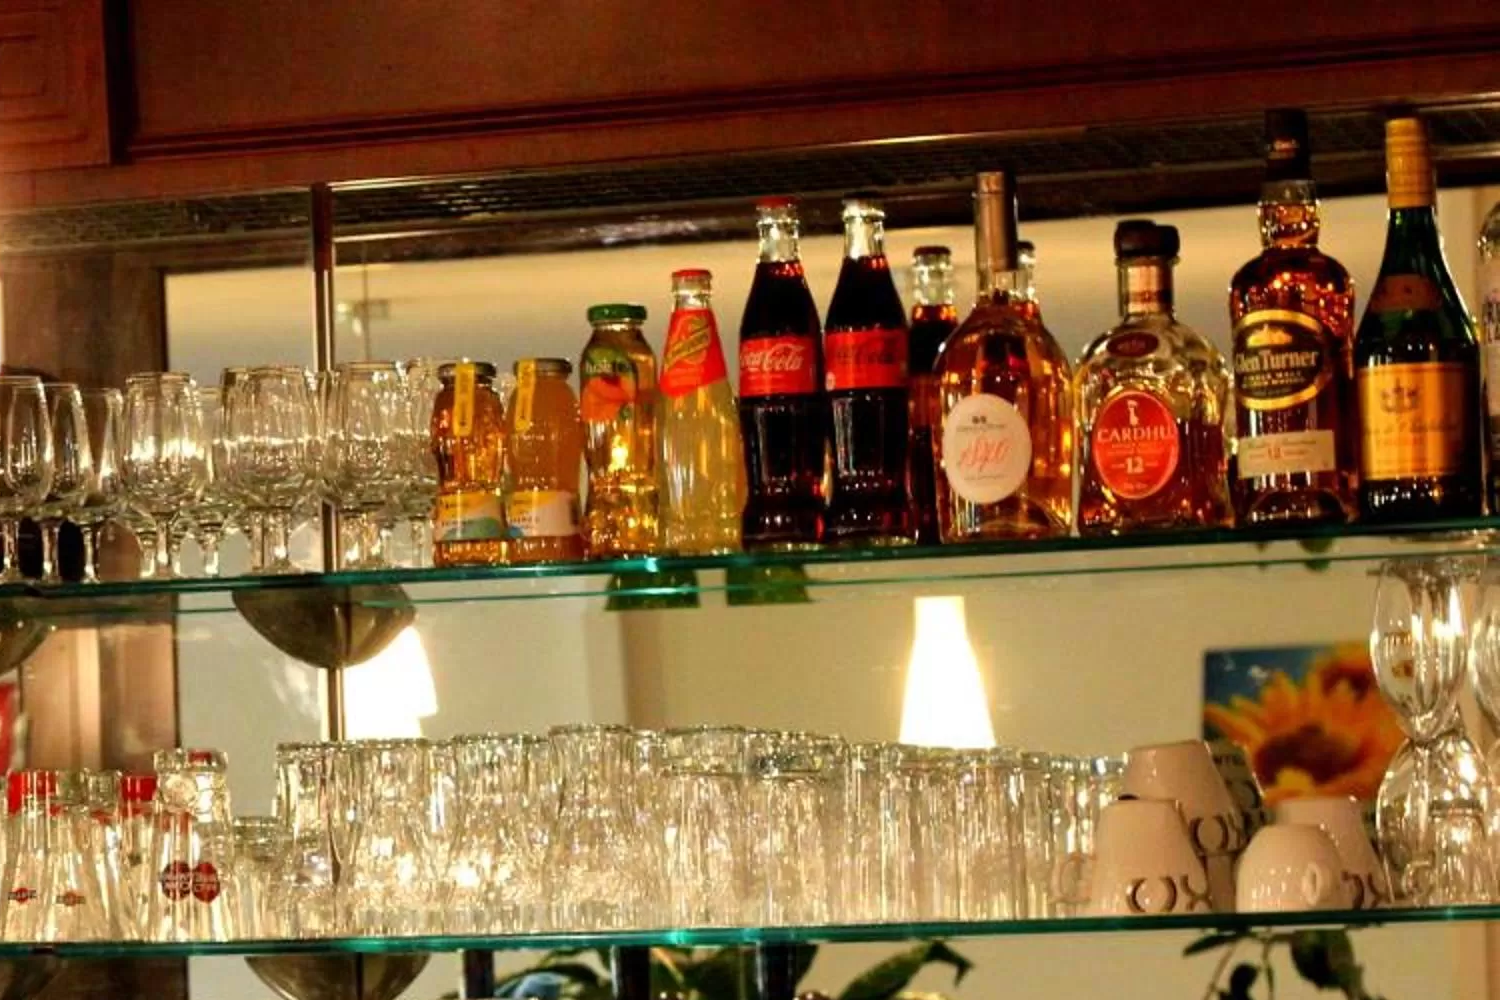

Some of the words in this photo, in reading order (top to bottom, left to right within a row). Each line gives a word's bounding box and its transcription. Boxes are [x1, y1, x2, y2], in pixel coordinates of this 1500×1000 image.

[1259, 349, 1317, 371] Turner
[1098, 425, 1170, 443] CARDHU
[1124, 456, 1144, 475] 12
